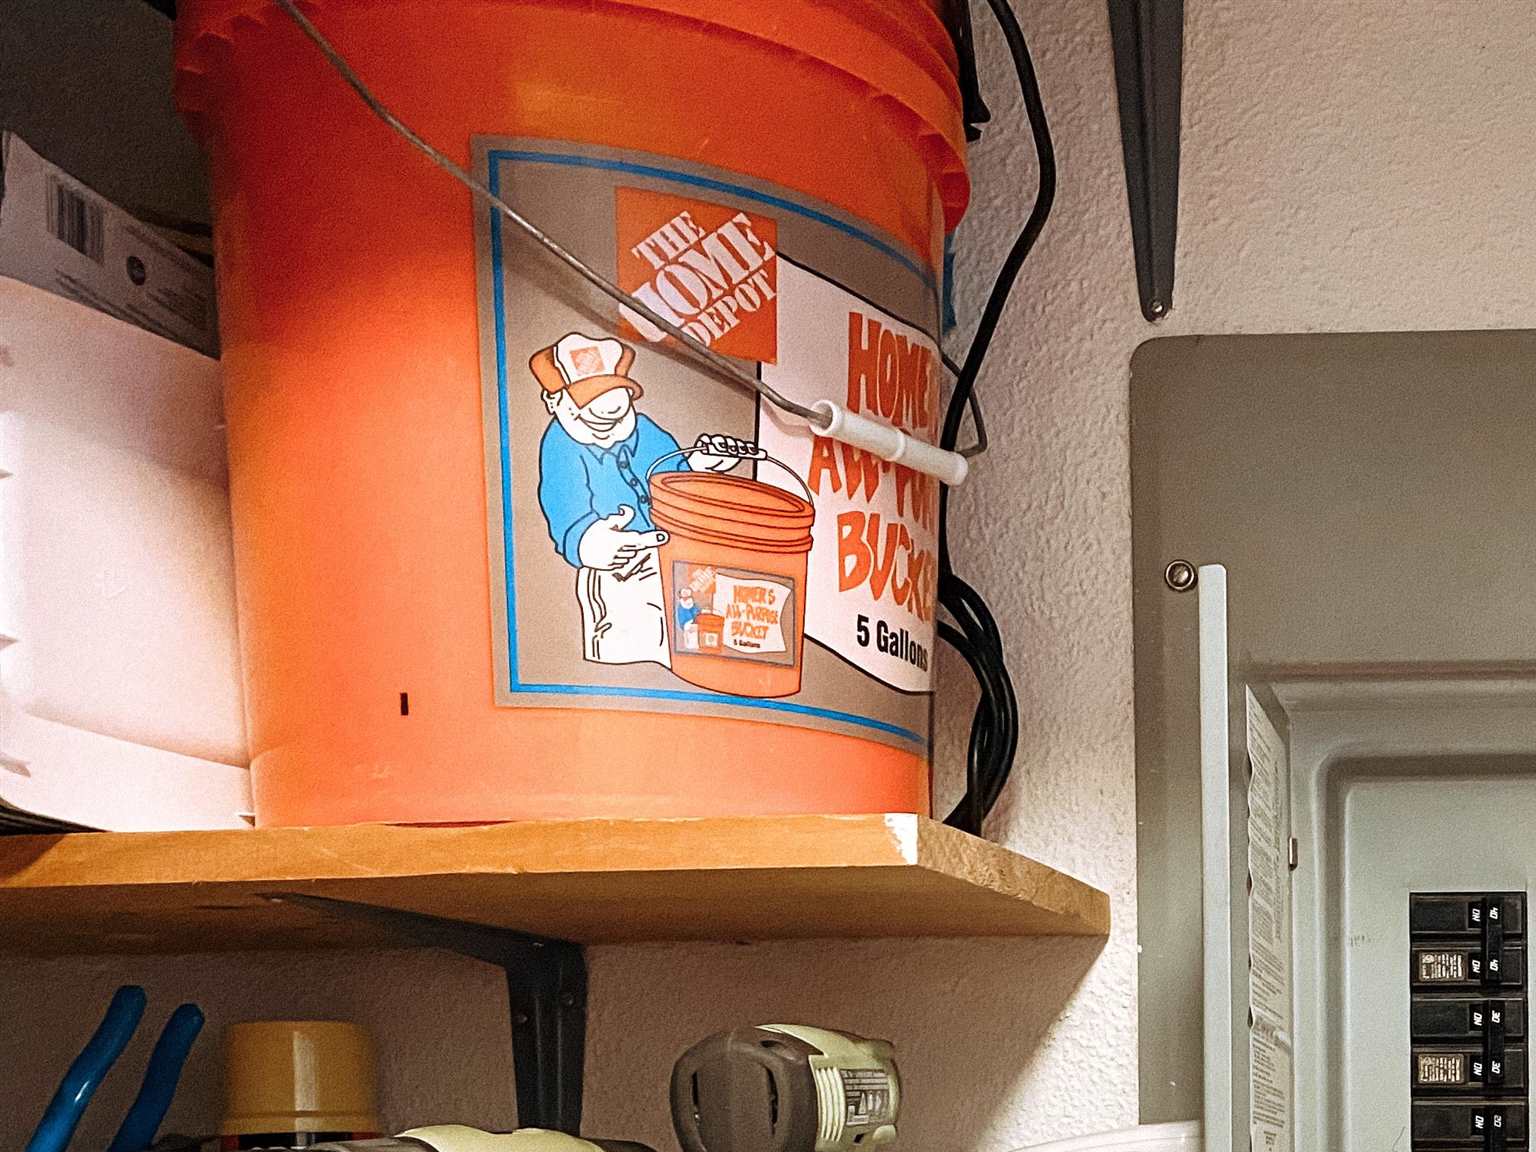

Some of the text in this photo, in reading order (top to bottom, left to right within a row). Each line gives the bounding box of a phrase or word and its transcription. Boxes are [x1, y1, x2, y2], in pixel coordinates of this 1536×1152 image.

[632, 211, 706, 270] THE
[619, 213, 775, 342] HOME
[681, 269, 776, 347] DEPOT
[857, 613, 929, 672] 5 Gallons
